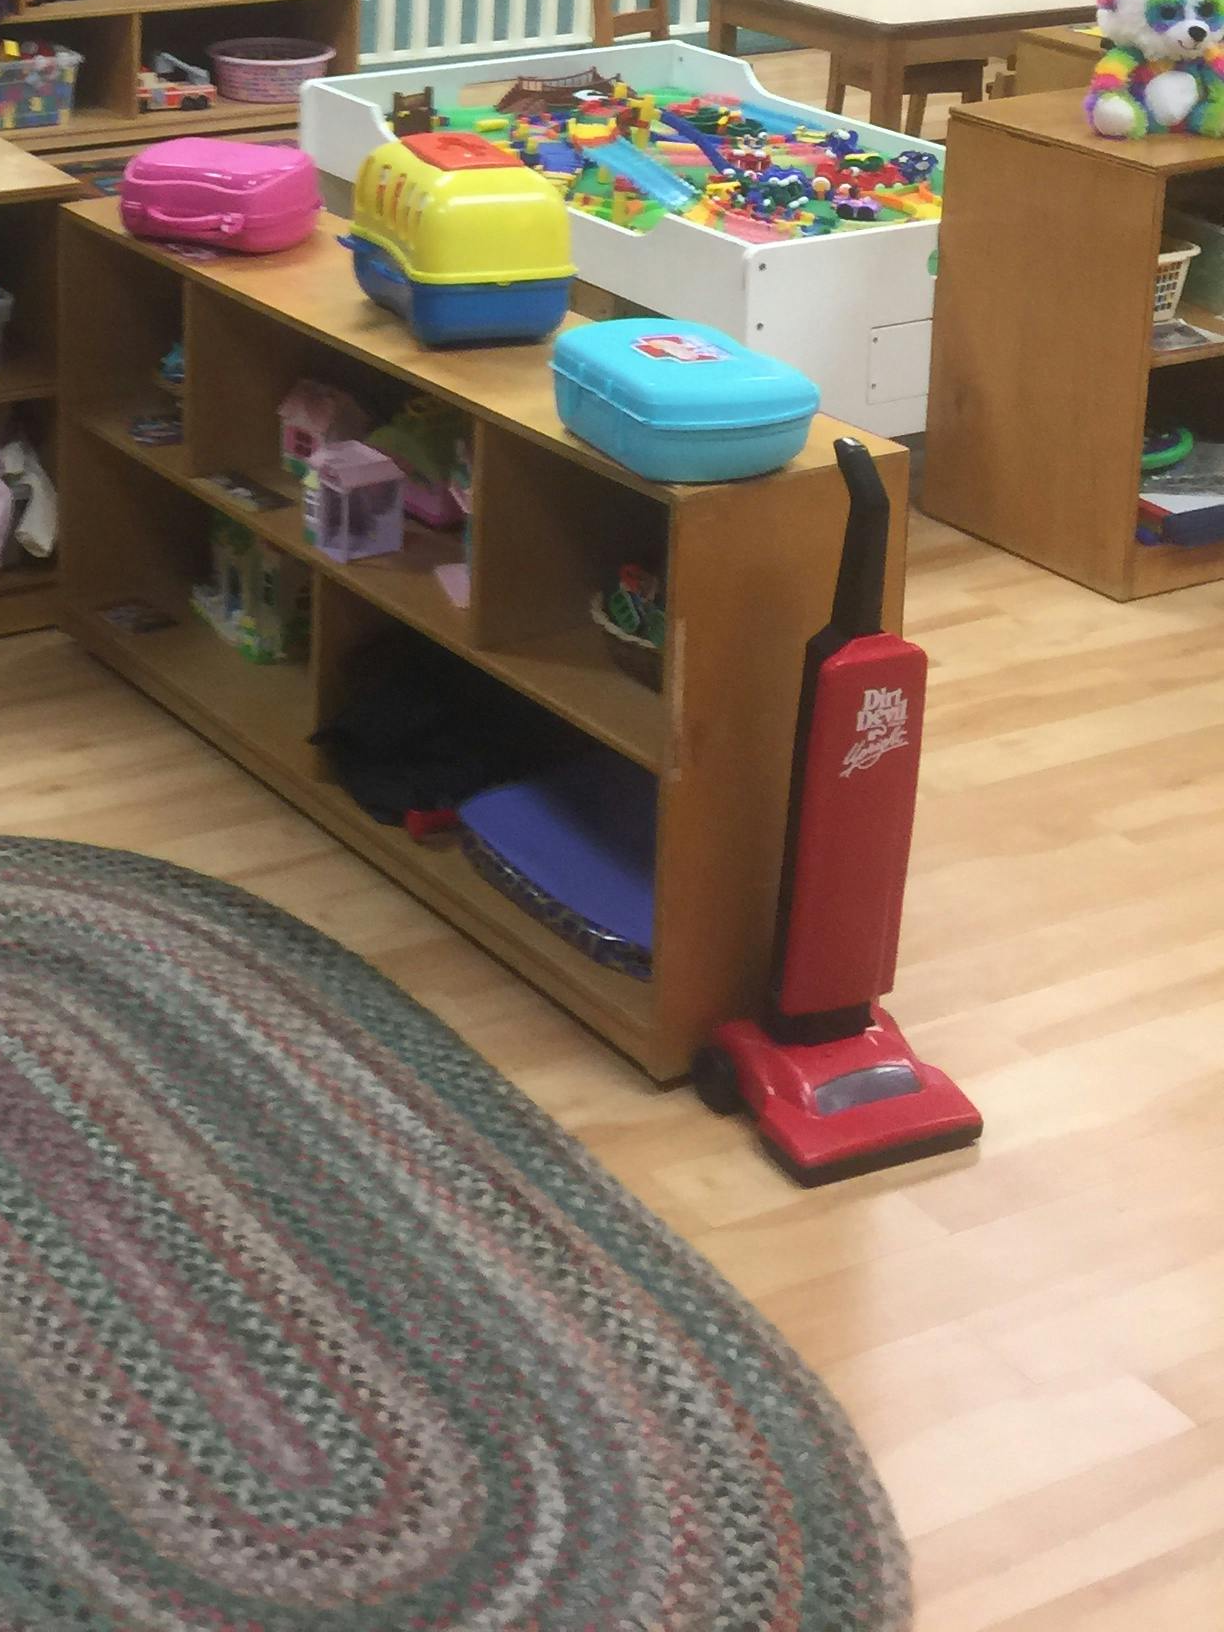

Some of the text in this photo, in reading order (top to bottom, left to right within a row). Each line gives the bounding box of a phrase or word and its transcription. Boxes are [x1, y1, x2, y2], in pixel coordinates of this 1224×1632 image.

[856, 699, 908, 732] Devil
[863, 687, 903, 711] Dirt
[839, 726, 910, 778] Upright
